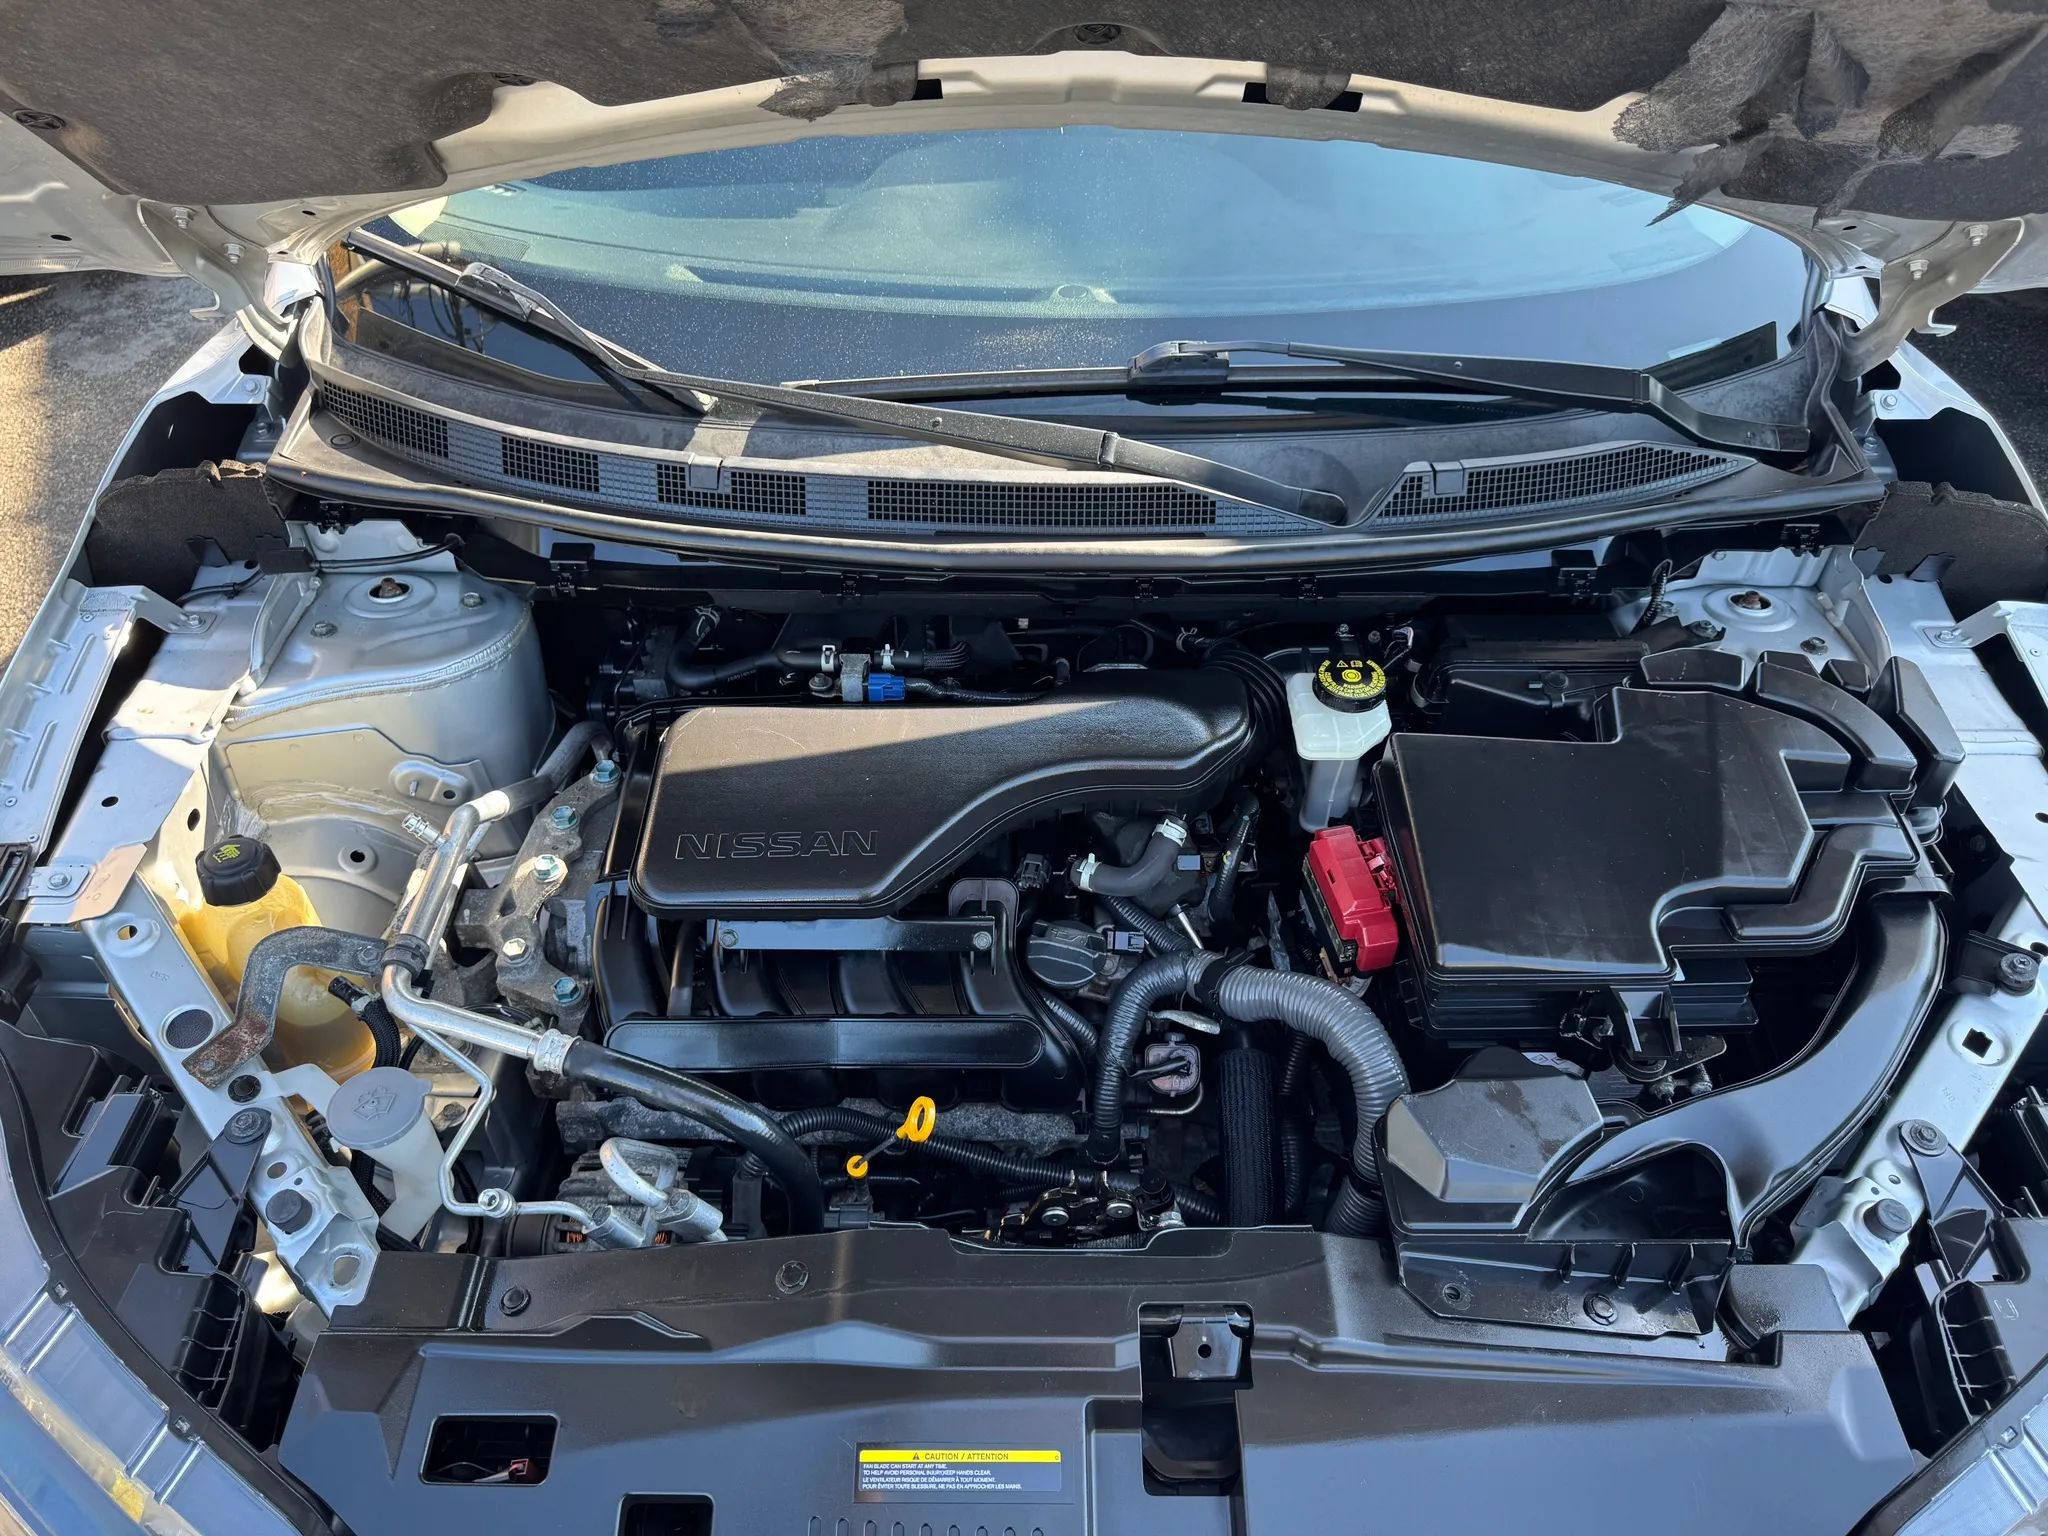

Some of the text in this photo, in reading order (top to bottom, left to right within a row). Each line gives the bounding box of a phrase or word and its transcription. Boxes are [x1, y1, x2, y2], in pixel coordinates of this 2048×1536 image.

[675, 830, 879, 860] NISSAN
[925, 1452, 959, 1460] CAUTION
[967, 1452, 1009, 1460] ATTENTION
